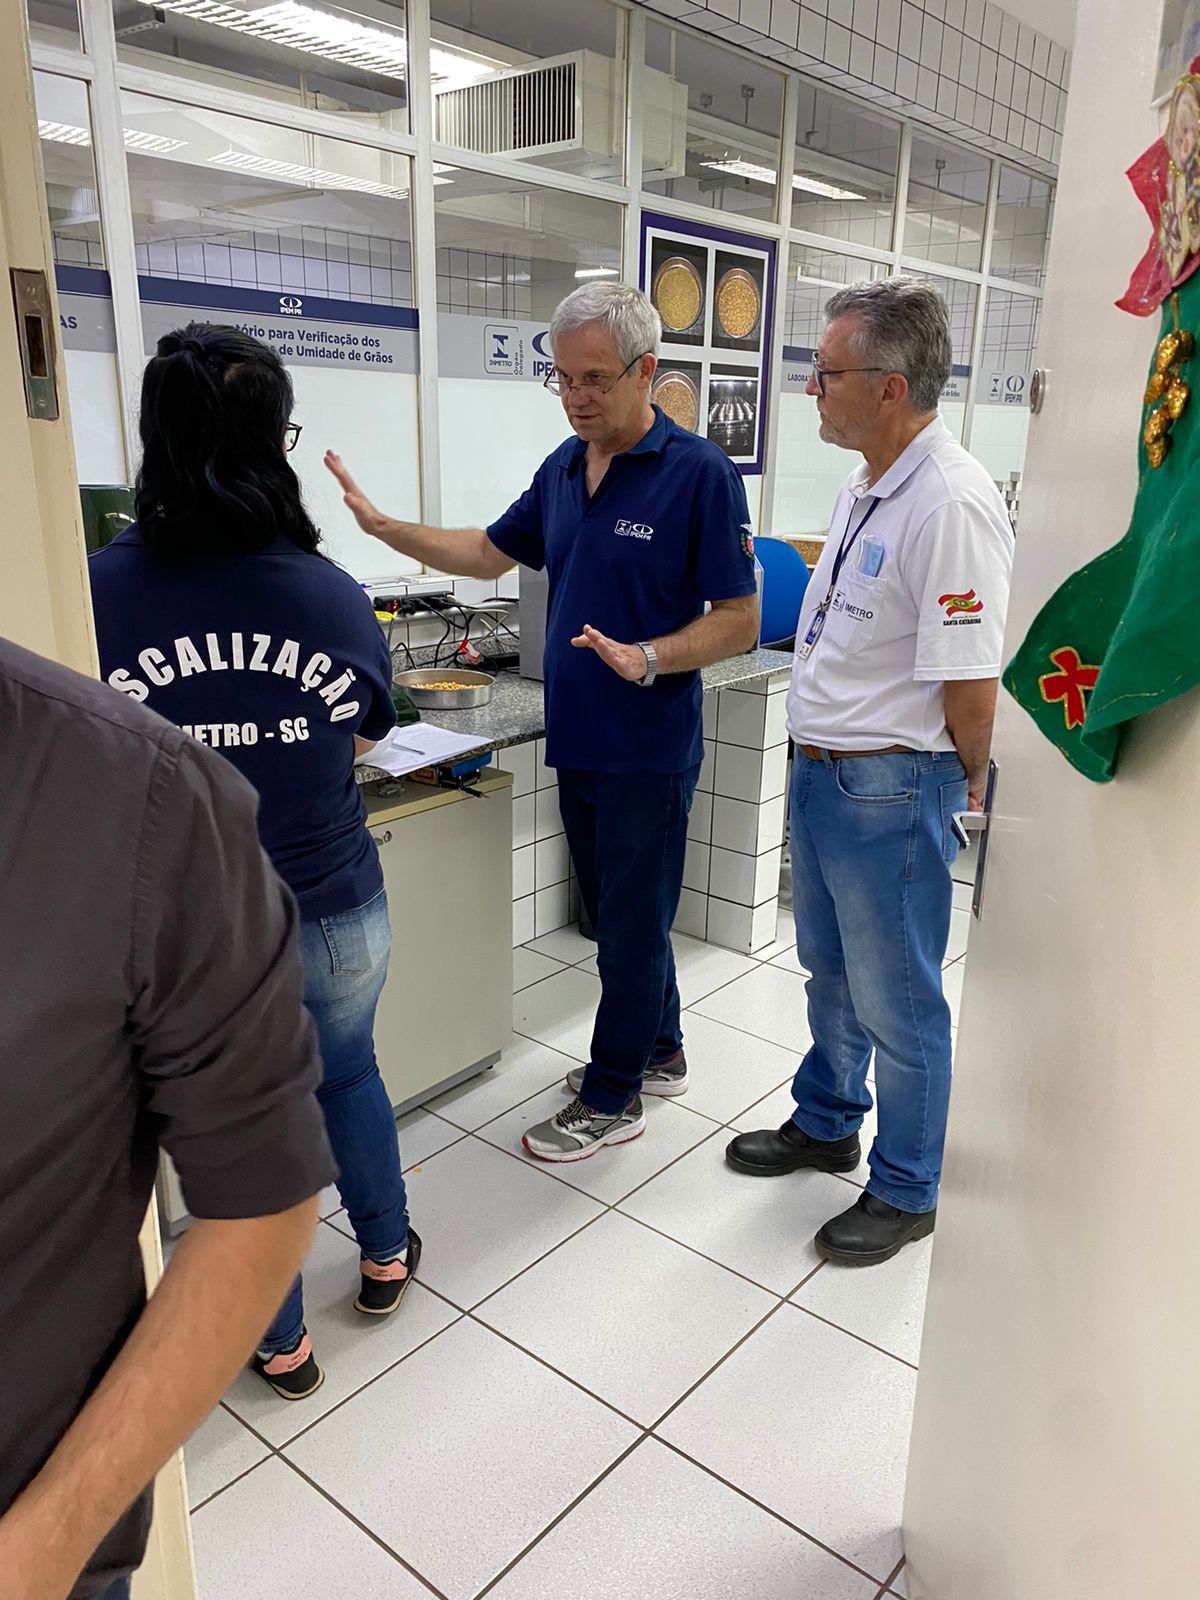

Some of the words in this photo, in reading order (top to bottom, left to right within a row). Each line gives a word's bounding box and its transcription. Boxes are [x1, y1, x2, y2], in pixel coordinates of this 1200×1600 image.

[294, 307, 303, 316] PR
[60, 314, 78, 329] AS
[268, 328, 294, 340] para
[297, 329, 359, 346] Verificação
[361, 336, 380, 348] dos
[279, 344, 293, 356] de
[296, 345, 346, 360] Umidade
[348, 349, 361, 361] de
[363, 351, 393, 364] Grãos
[787, 373, 808, 382] LABORA
[845, 602, 874, 620] IMETRO
[107, 632, 360, 723] SCALIZAÇÃO
[279, 716, 310, 744] SC
